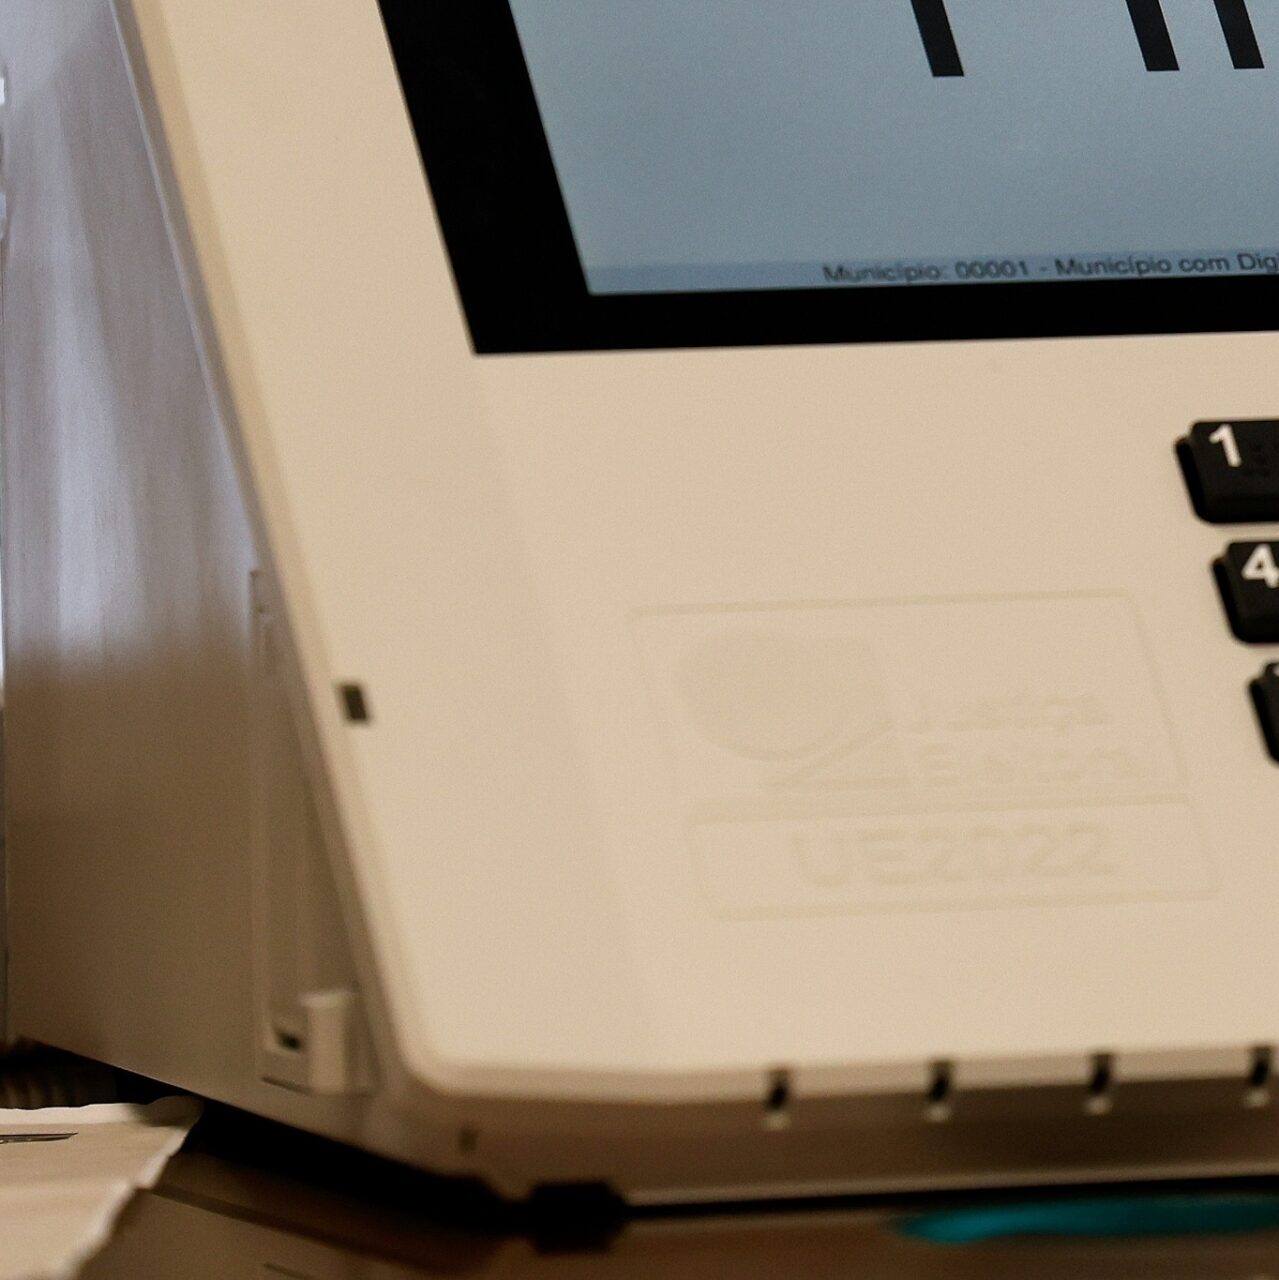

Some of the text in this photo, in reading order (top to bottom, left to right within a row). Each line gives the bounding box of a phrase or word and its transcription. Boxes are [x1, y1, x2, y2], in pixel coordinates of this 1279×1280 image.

[954, 259, 1030, 280] 00001
[1054, 255, 1173, 278] Município
[1178, 255, 1231, 274] com
[1209, 423, 1243, 467] 1
[790, 821, 1118, 889] UE2022
